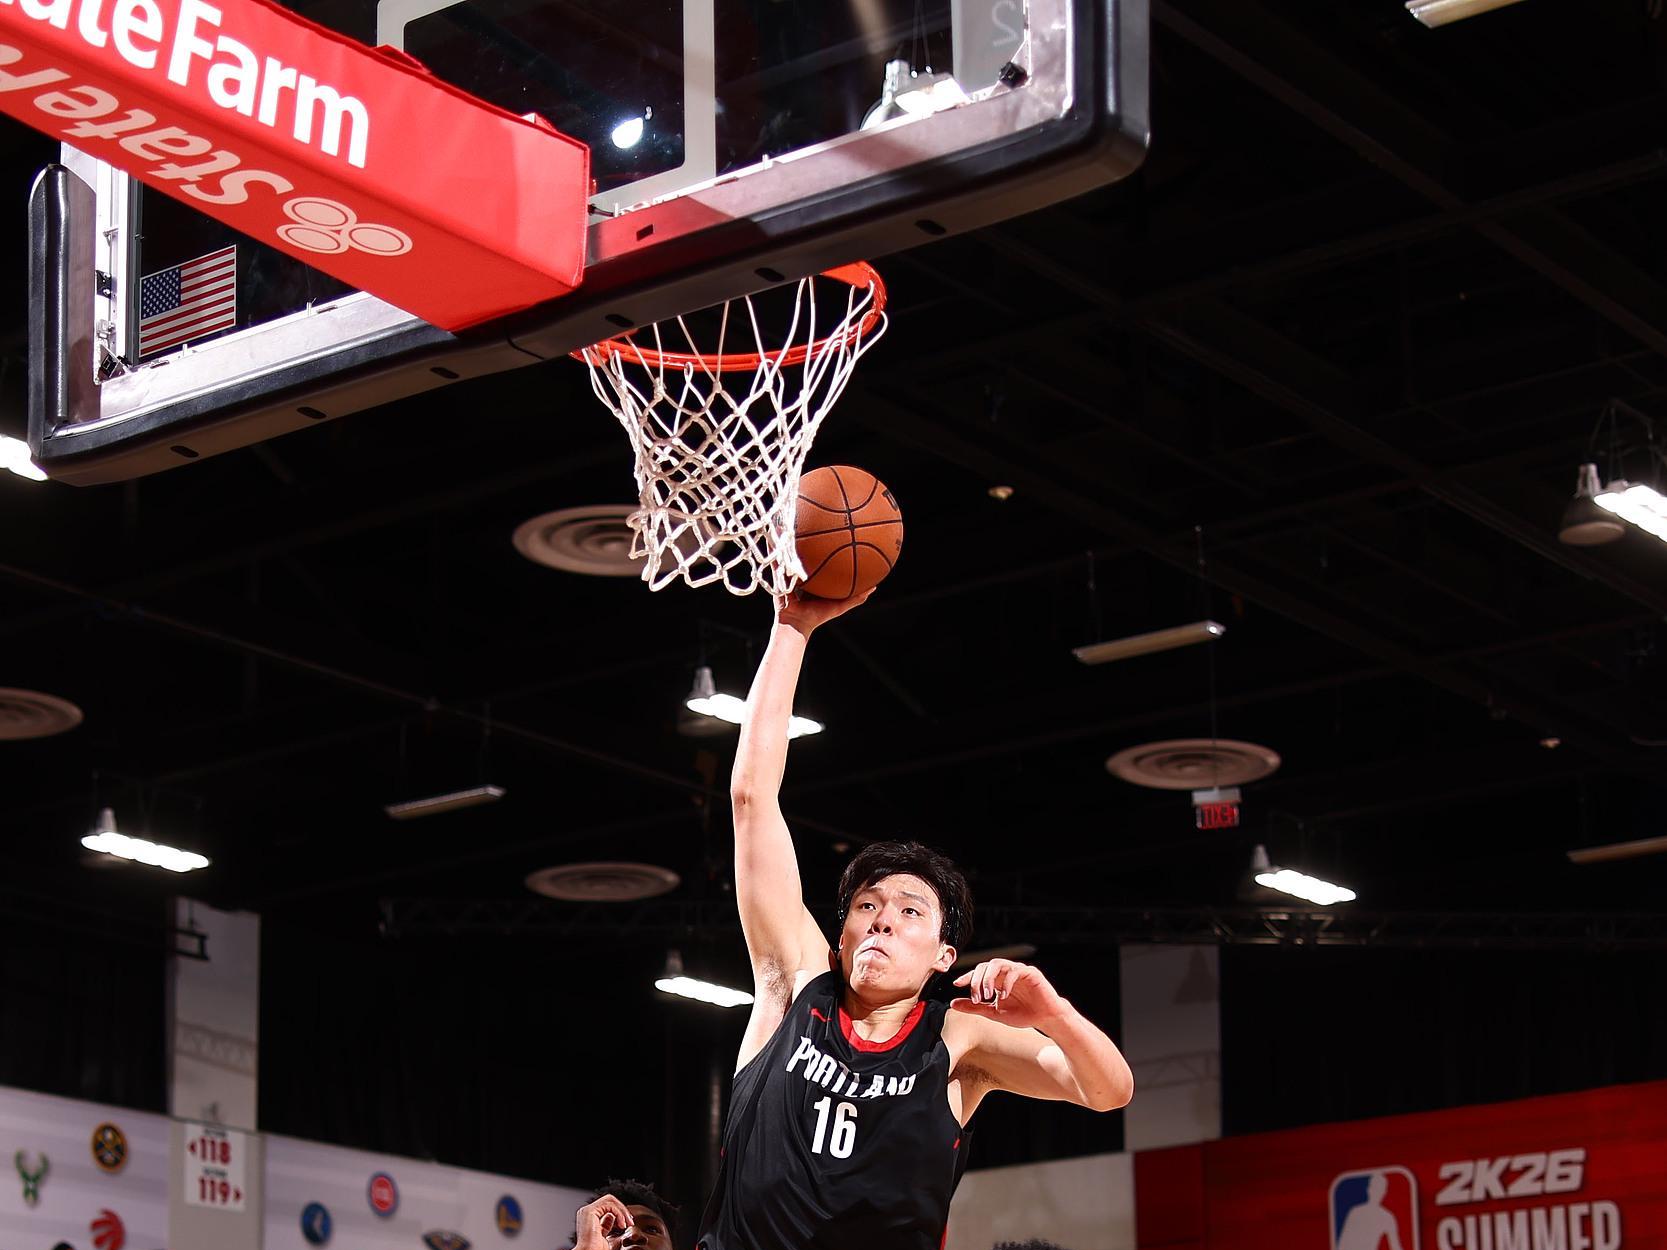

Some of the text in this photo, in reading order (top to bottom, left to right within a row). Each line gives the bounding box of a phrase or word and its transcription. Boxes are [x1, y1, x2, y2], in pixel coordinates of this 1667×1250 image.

[811, 1096, 858, 1159] 16
[200, 1137, 231, 1166] 118
[199, 1177, 230, 1205] 119
[1435, 1148, 1586, 1206] 2K26
